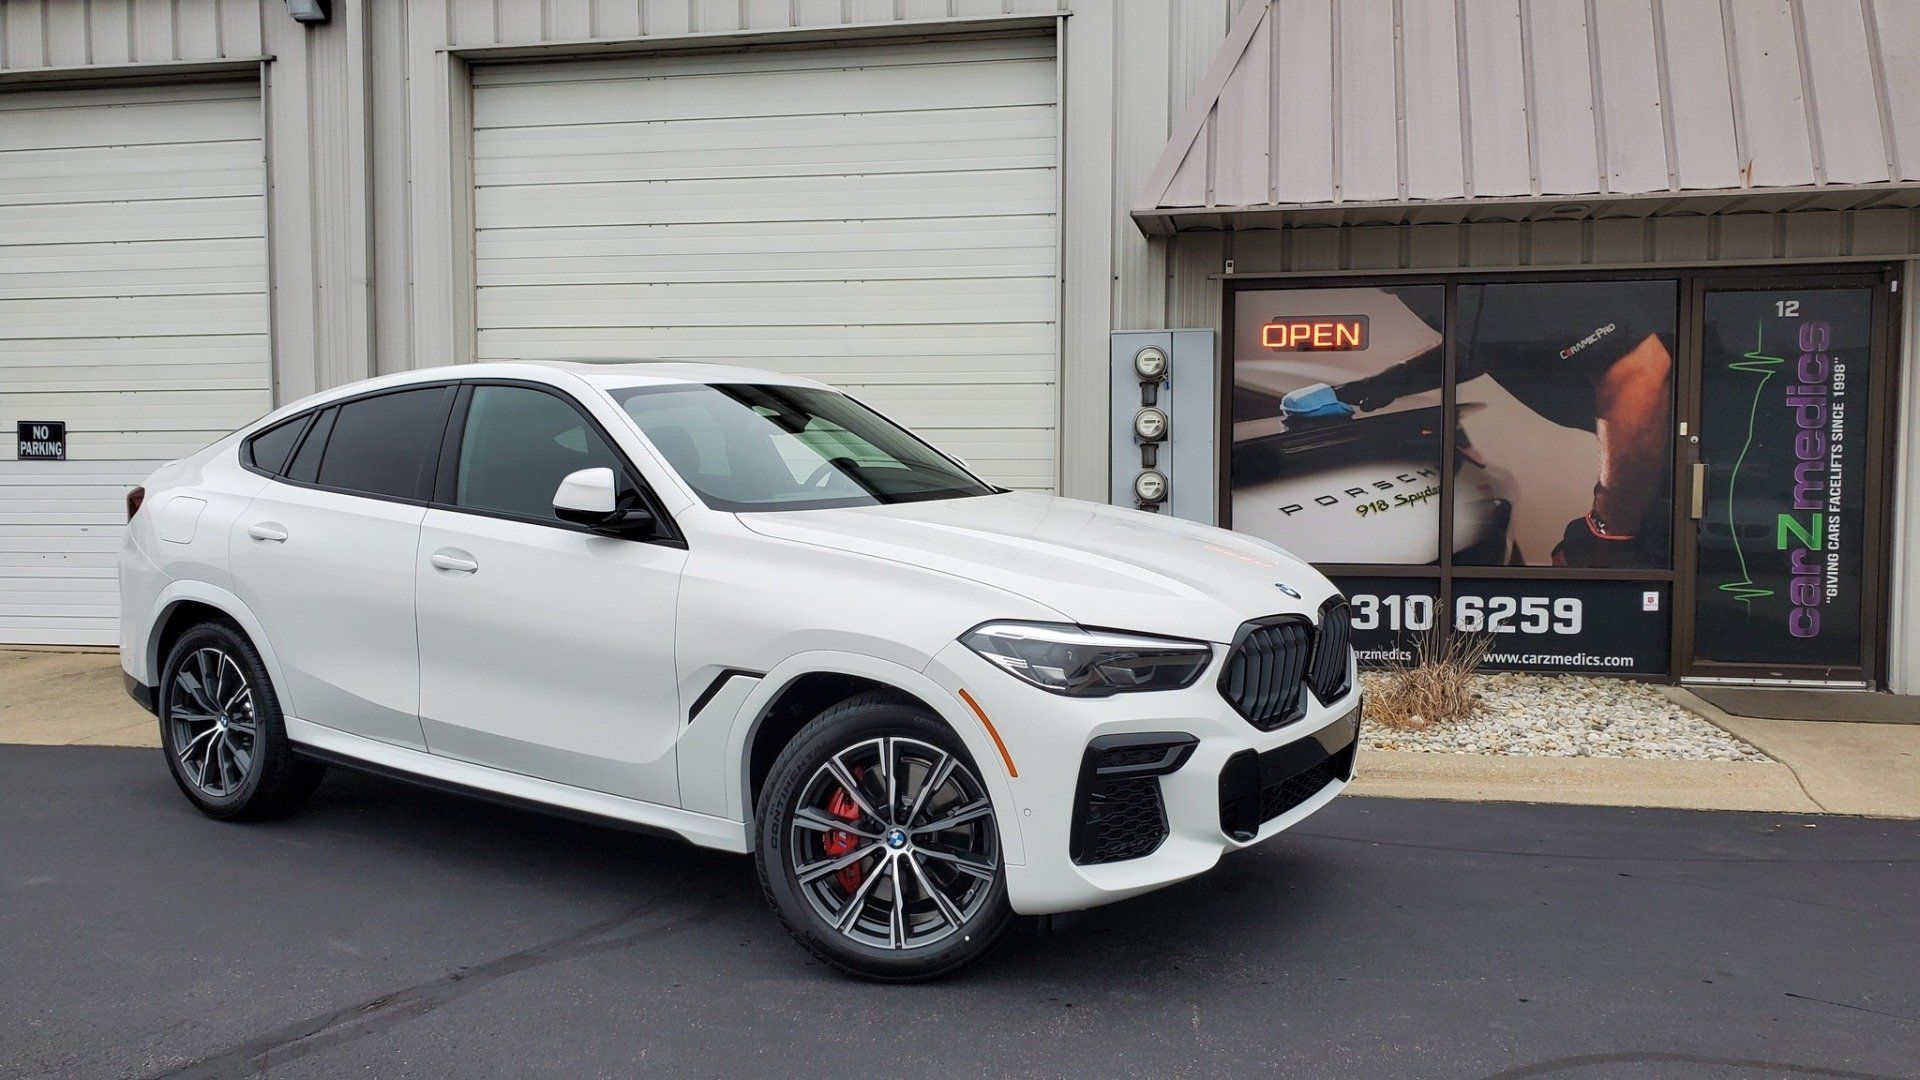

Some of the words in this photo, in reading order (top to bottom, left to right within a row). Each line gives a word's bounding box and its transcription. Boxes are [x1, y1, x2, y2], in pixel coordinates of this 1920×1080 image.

[1775, 300, 1800, 317] 12
[1262, 323, 1360, 348] OPEN
[32, 425, 49, 440] NO
[1831, 402, 1845, 443] SINCE
[20, 441, 62, 456] PARKING
[1829, 444, 1843, 512] FACELIFTS
[1279, 468, 1437, 517] PORSCH
[1355, 499, 1390, 518] 918
[1827, 516, 1841, 550] CARS
[1351, 594, 1434, 631] 310
[1456, 595, 1583, 635] 6259
[1354, 649, 1412, 661] arzmedics
[1482, 652, 1634, 667] www.carzmedics.com
